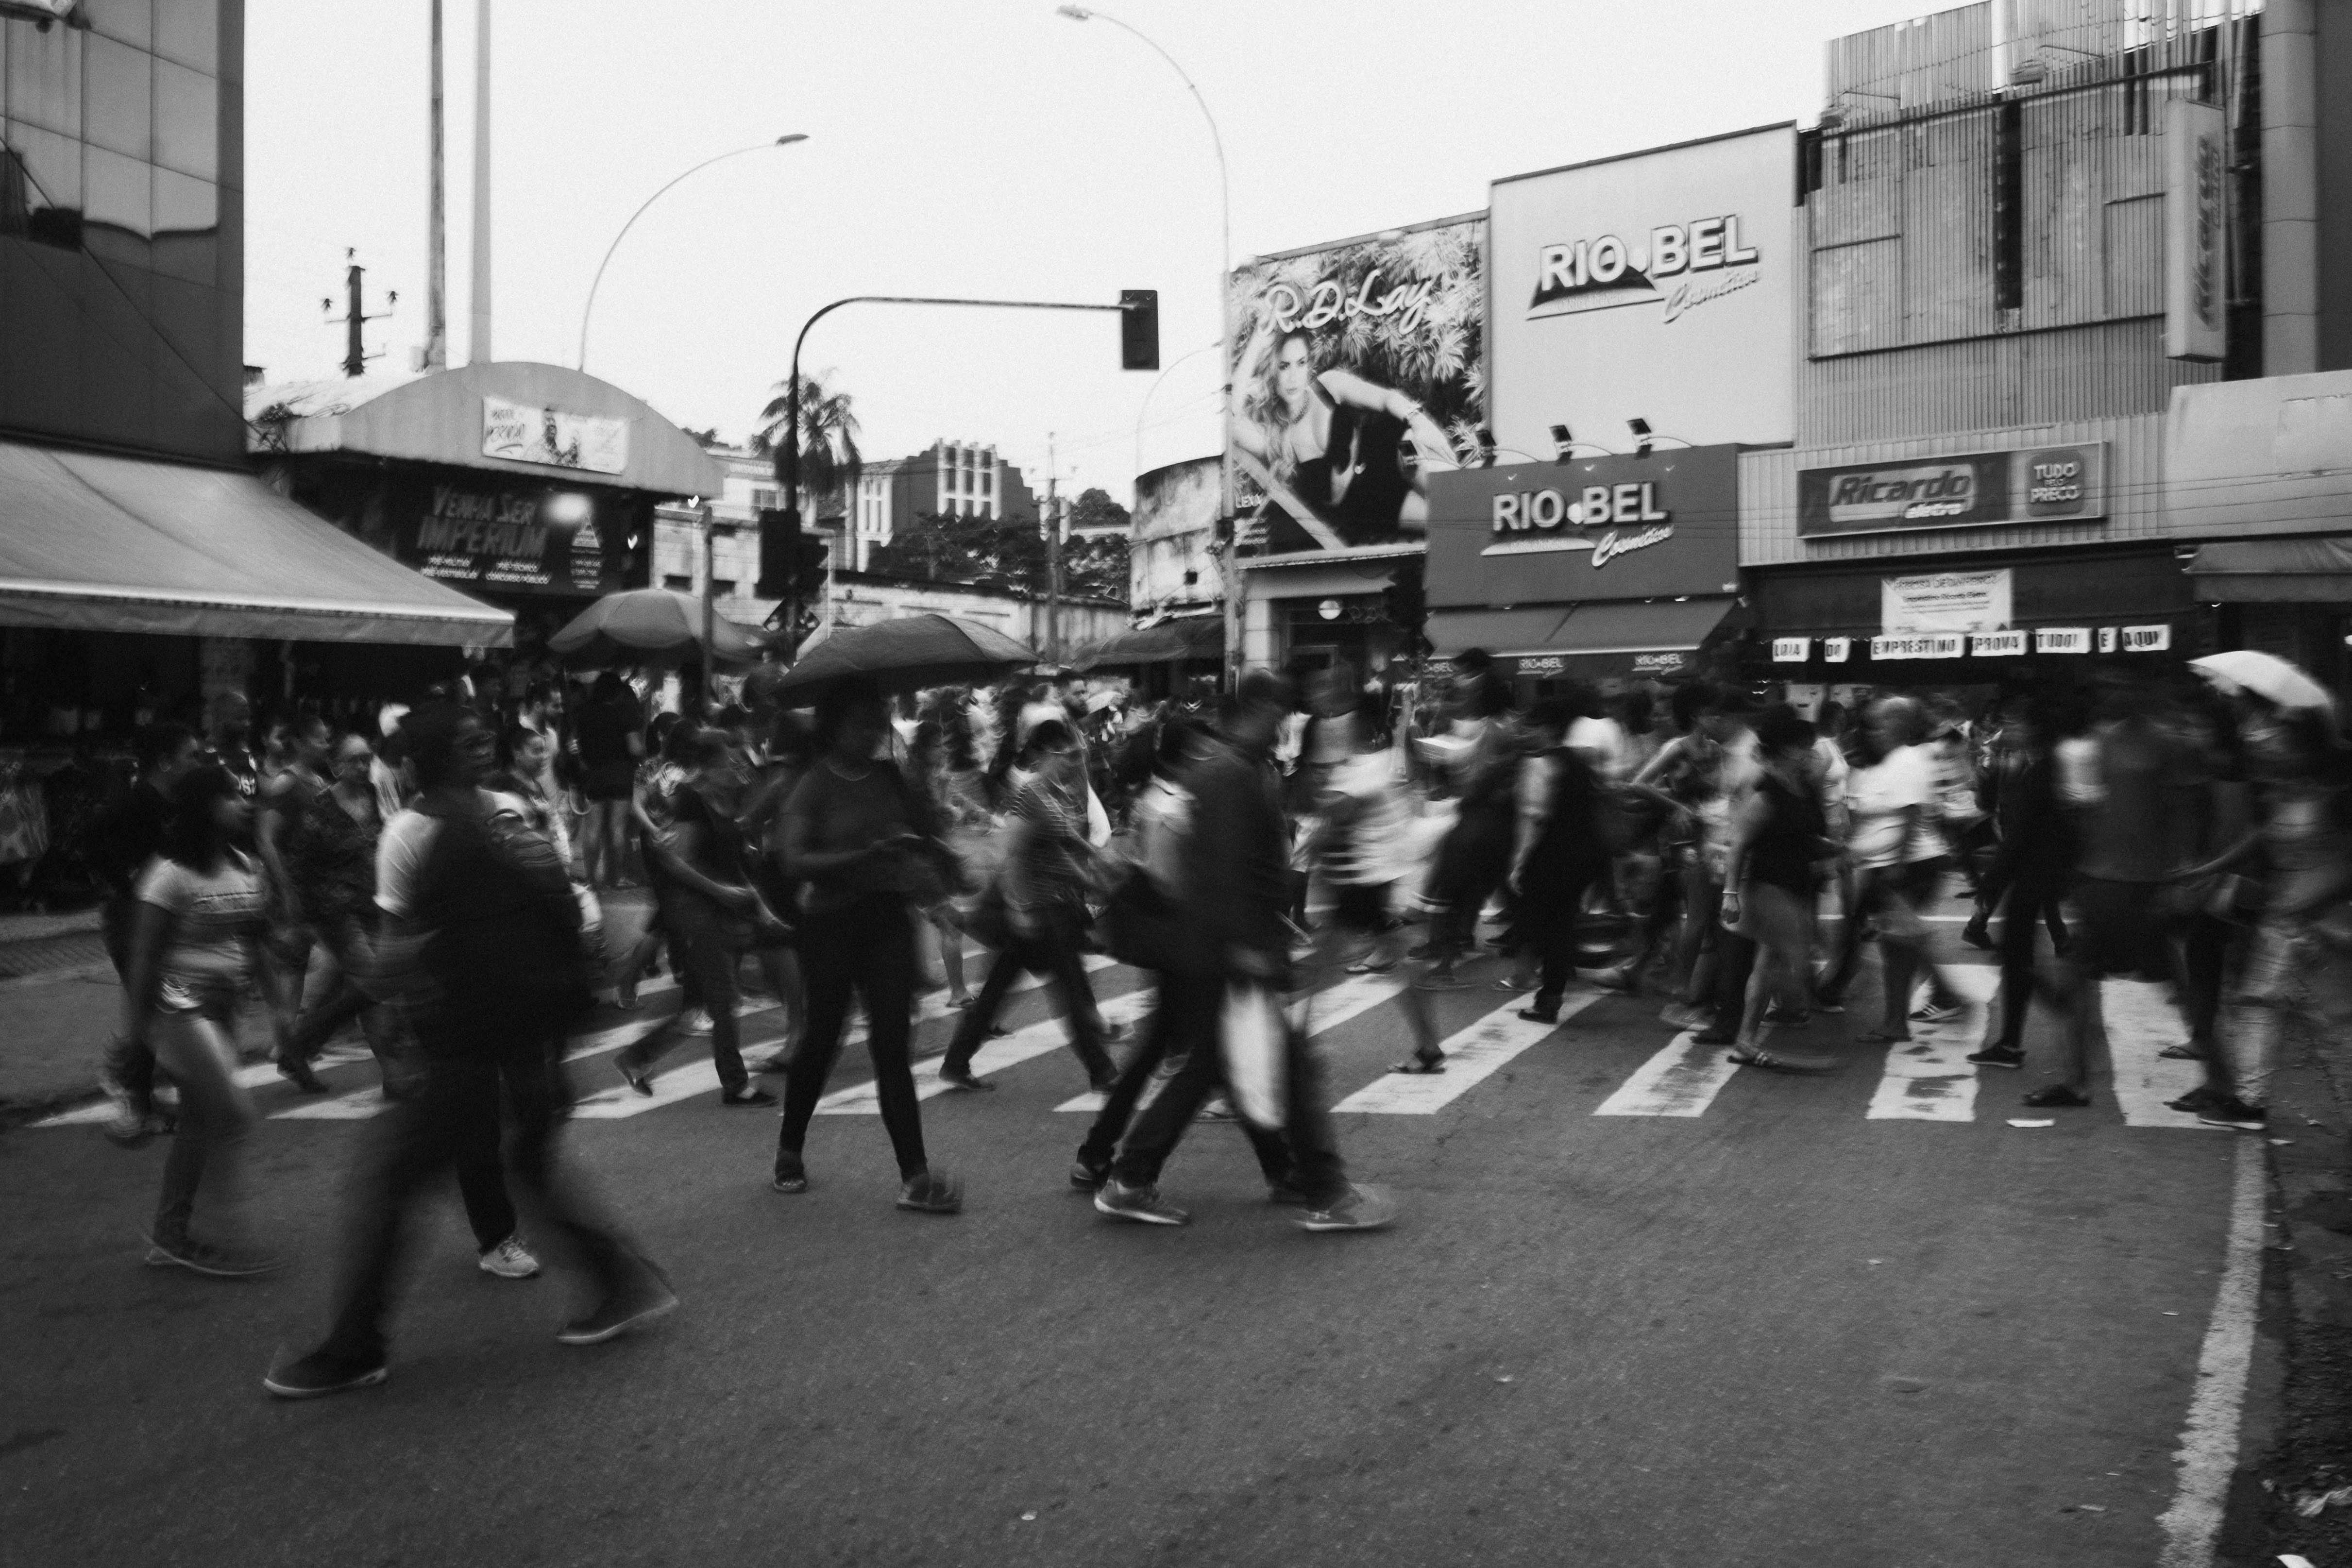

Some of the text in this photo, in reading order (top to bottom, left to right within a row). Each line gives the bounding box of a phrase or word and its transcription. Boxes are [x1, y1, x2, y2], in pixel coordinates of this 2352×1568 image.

[1540, 214, 1758, 291] RIO BEL
[2033, 461, 2080, 481] TUDO
[1830, 470, 1971, 506] Ricardo
[1492, 482, 1669, 531] RIO BEL
[1904, 500, 1967, 519] eletro
[416, 516, 549, 557] IMPERIUM
[1541, 657, 1563, 668] BEL
[1658, 653, 1683, 665] BEL
